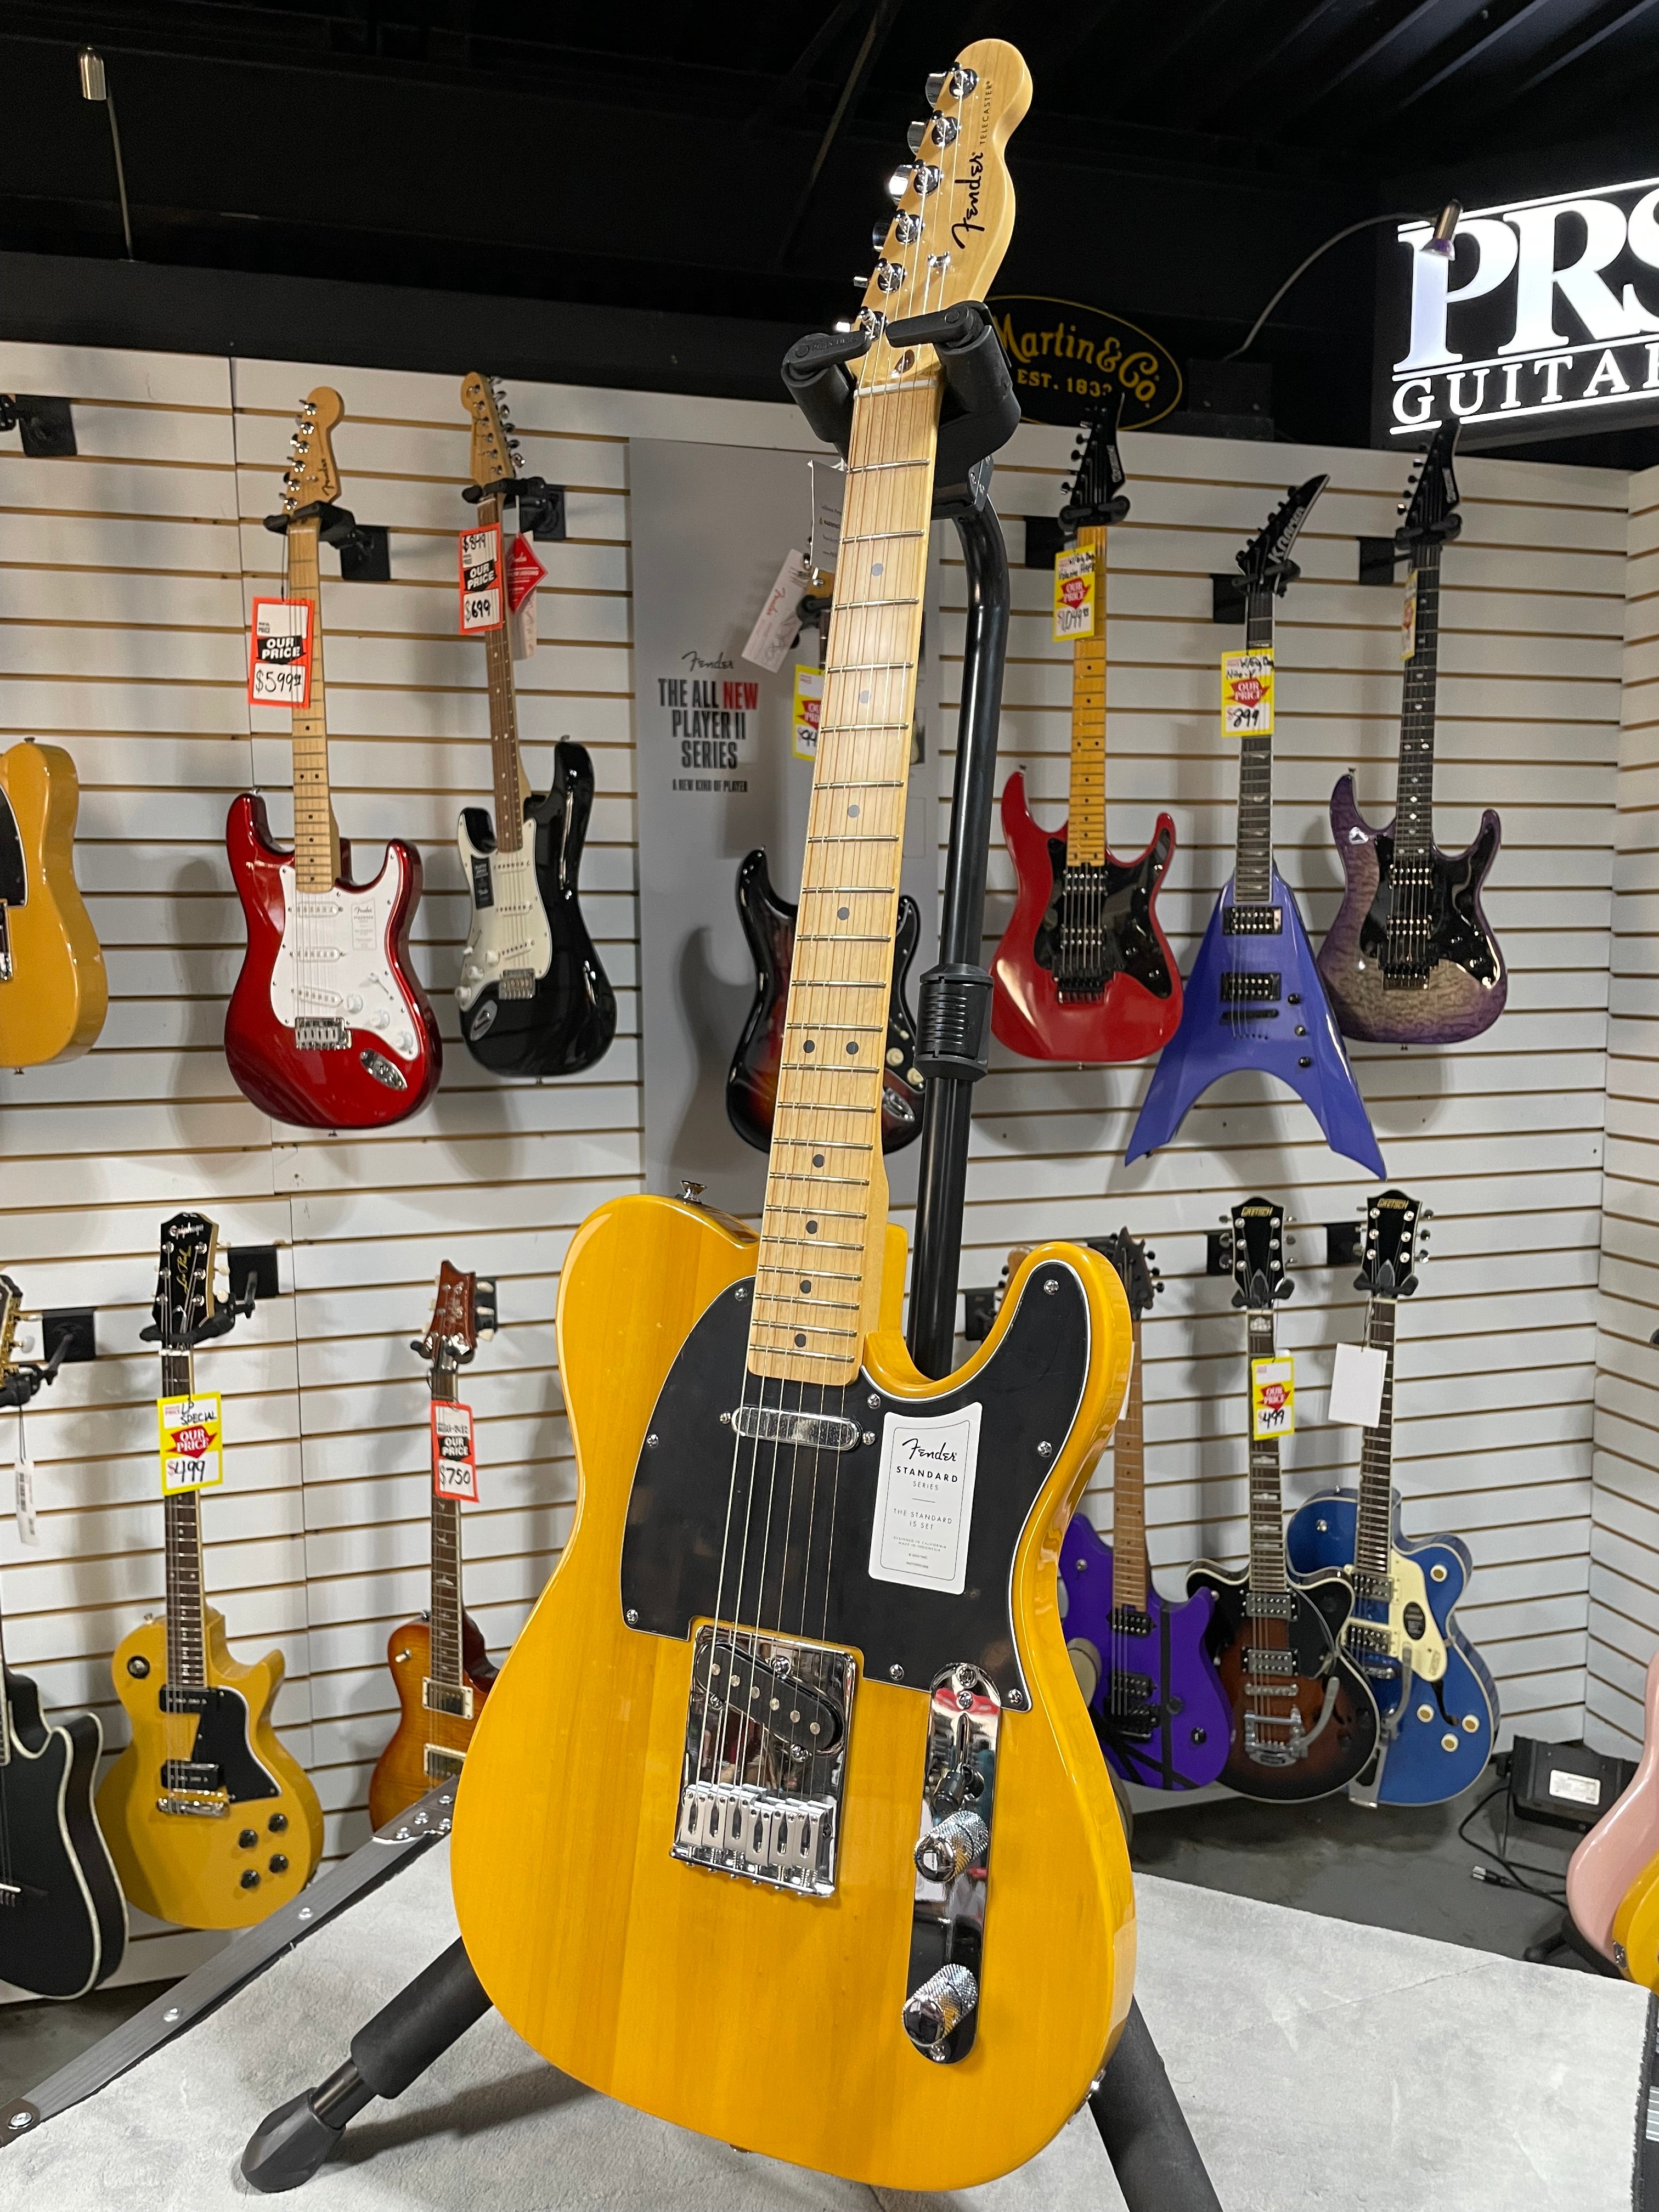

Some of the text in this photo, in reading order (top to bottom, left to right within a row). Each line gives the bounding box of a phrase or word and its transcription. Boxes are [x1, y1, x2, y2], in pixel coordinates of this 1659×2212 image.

[980, 81, 993, 145] TELECASTER
[952, 152, 985, 249] Fender
[1017, 369, 1059, 390] EST.
[470, 563, 490, 579] OUR
[467, 571, 495, 590] PRICE
[465, 599, 491, 623] $699
[266, 637, 295, 648] OUR
[262, 646, 301, 659] PRICE
[681, 651, 735, 672] Fender
[658, 678, 759, 710] THE ALL NEW
[1238, 681, 1259, 692] OUR
[1235, 690, 1262, 701] PRICE
[672, 710, 746, 740] PLAYER II
[681, 740, 738, 769] SERIES
[673, 778, 748, 792] A NEW KIND OF PLAYER
[1241, 1206, 1273, 1217] GRETSCH
[1377, 1198, 1409, 1210] GRETSCH
[179, 1428, 205, 1442] OUR
[443, 1437, 464, 1447] OUR
[176, 1437, 210, 1453] PRICE
[442, 1446, 469, 1457] PRICE
[902, 1438, 957, 1462] Fender
[440, 1465, 471, 1489] $750
[896, 1466, 957, 1482] STANDARD
[913, 1481, 939, 1491] SERIES
[894, 1508, 952, 1524] THE STANDARD
